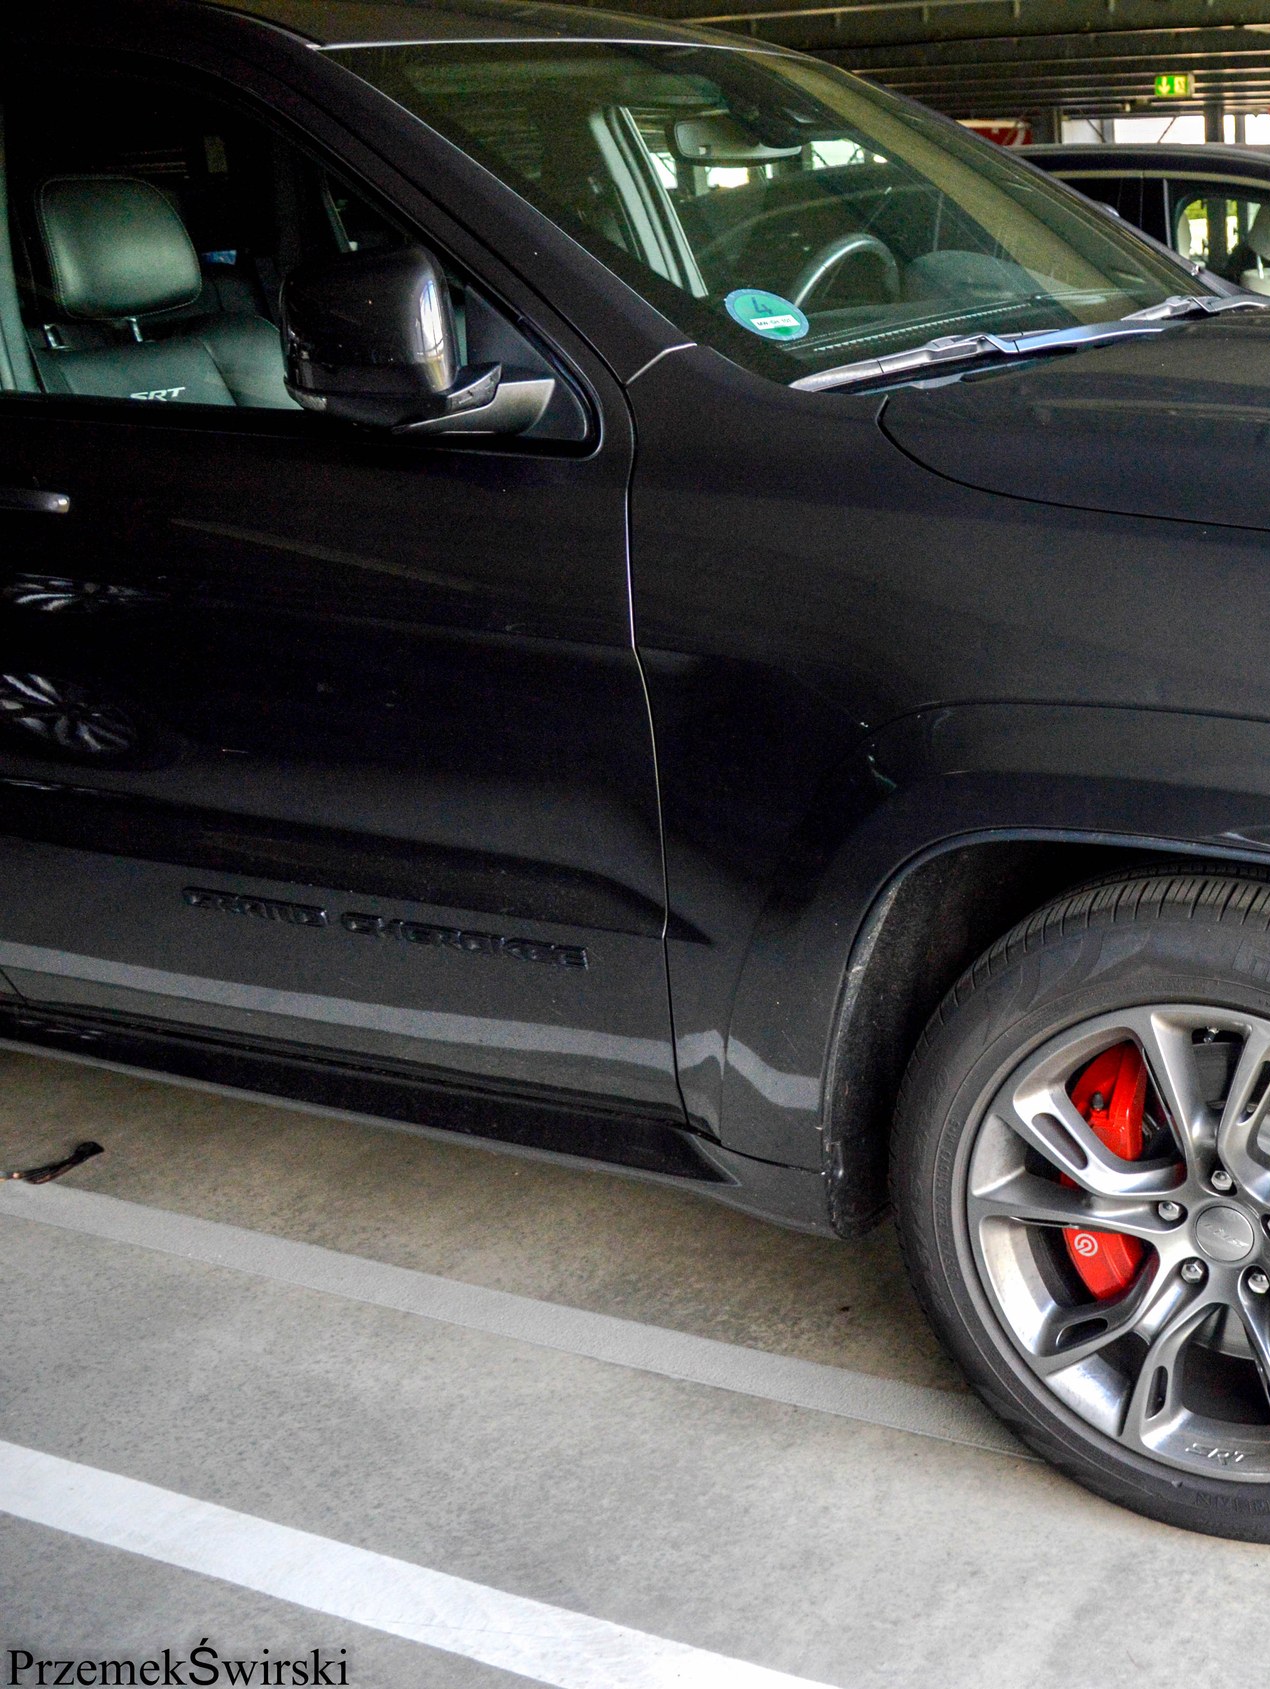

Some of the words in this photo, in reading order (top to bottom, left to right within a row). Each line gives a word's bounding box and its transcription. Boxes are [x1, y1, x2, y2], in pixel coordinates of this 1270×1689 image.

[751, 297, 773, 314] 4
[130, 386, 186, 401] SRT
[185, 887, 329, 927] GRAND
[342, 912, 590, 970] CHEROKEE
